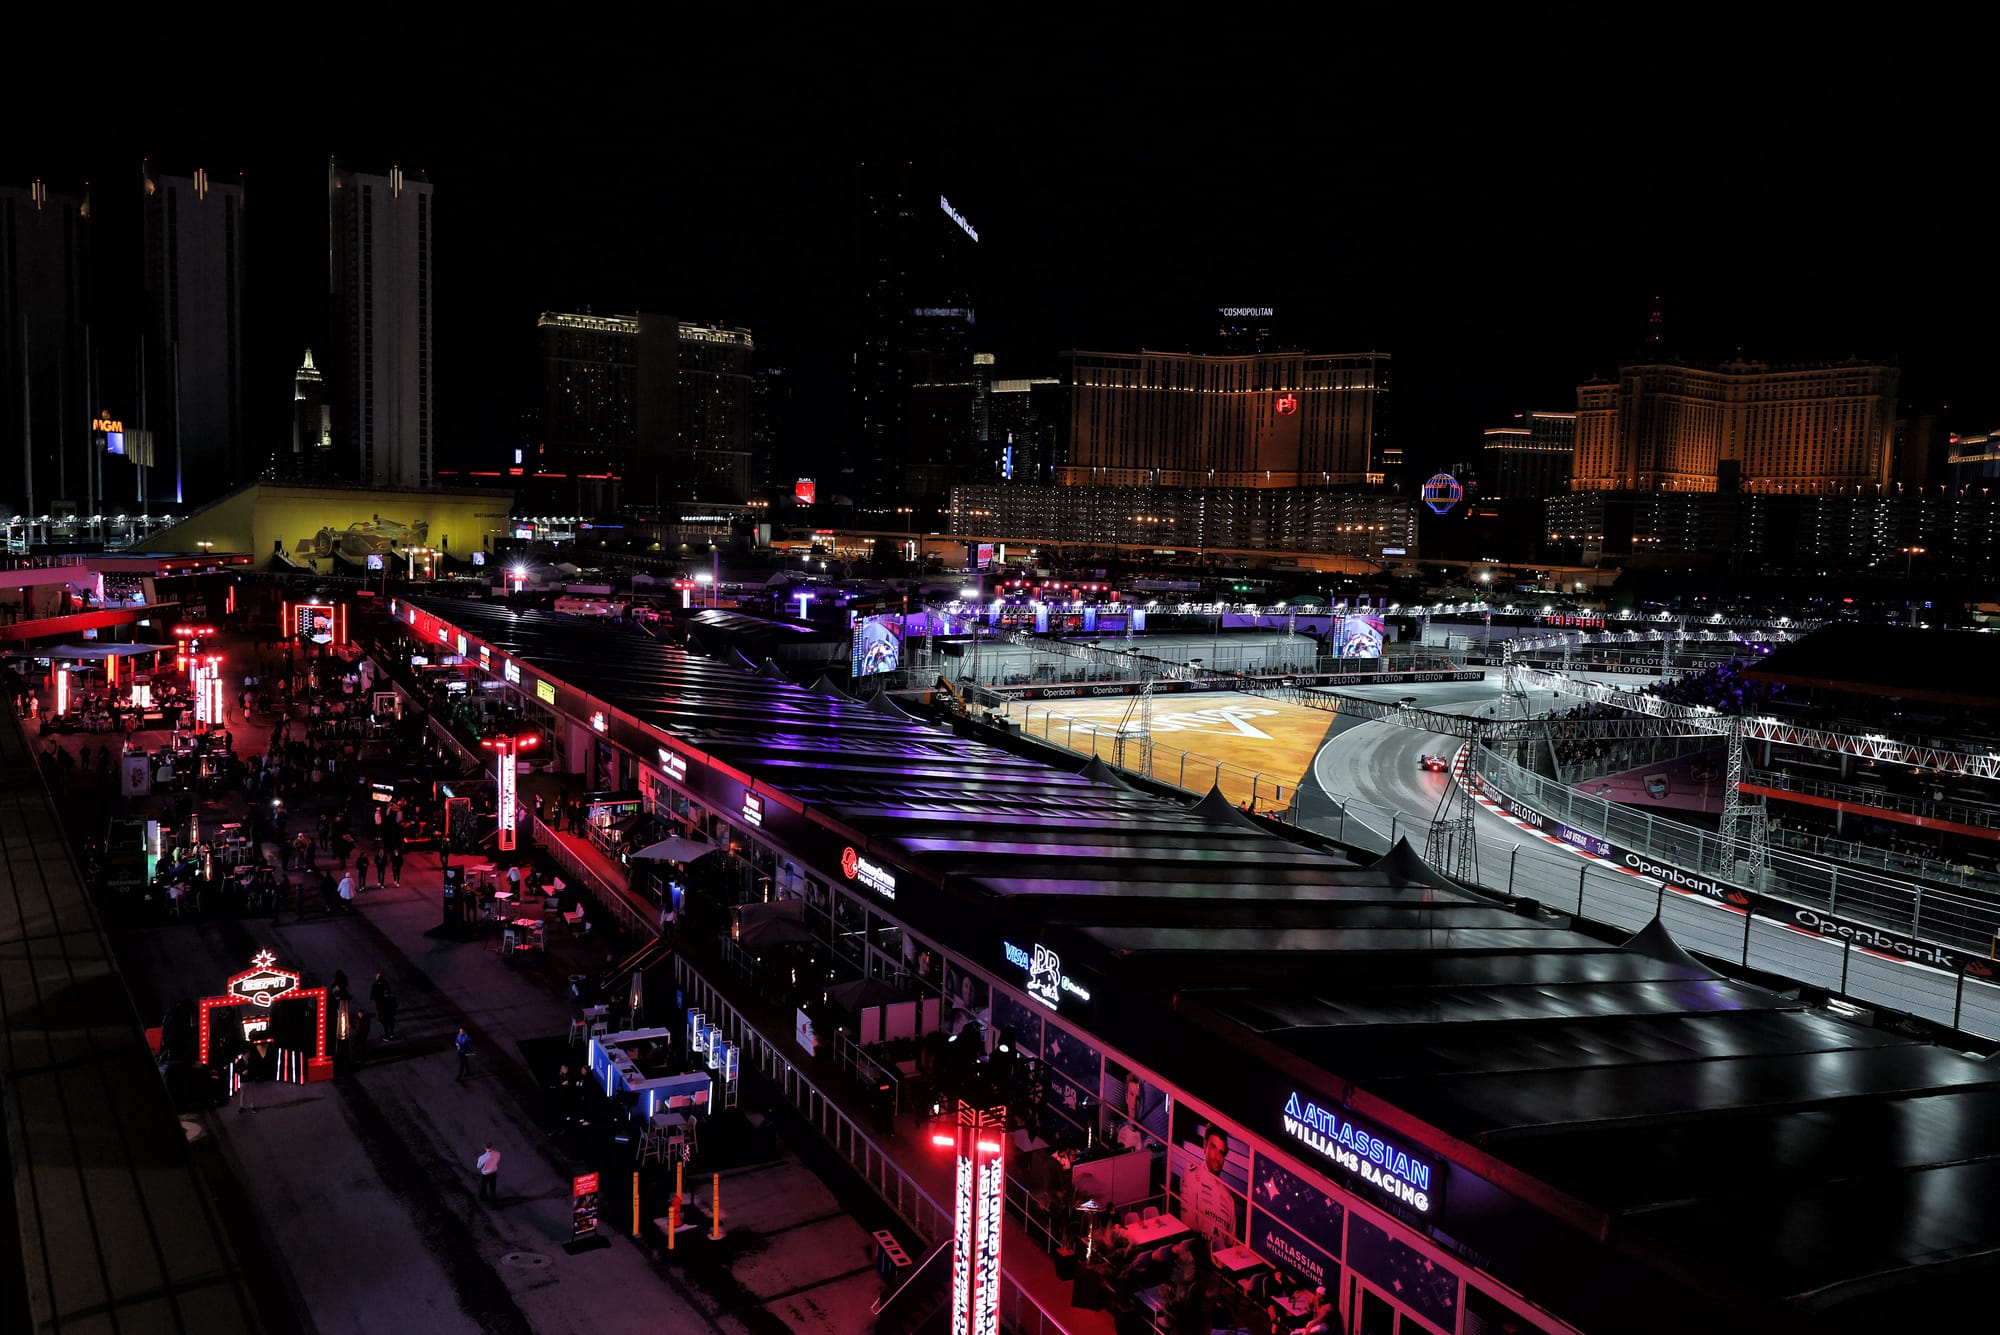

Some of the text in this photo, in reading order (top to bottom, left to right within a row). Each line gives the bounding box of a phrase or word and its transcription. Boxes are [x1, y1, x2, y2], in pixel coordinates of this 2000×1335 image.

[1223, 307, 1273, 316] COSMOPOLITAN
[93, 419, 123, 432] MGM
[1606, 665, 1650, 674] PELOTON
[1692, 660, 1722, 668] PELOT
[1329, 676, 1361, 685] PELOTON
[1372, 674, 1403, 683] PELOTON
[1414, 673, 1443, 682] PELOTON
[1453, 672, 1481, 680] PELOTON
[1043, 687, 1076, 698] Openbank
[1092, 686, 1124, 696] Openbank
[1482, 782, 1503, 804] PELOTON
[1510, 802, 1543, 827] PELOTON
[1563, 828, 1572, 841] LAS
[1571, 832, 1587, 847] VEGAS
[1625, 853, 1725, 898] Openbank
[1795, 910, 1954, 967] Openbank
[1004, 941, 1029, 970] VISA
[242, 977, 286, 992] ESPN
[1303, 1102, 1430, 1190] ATLASSIAN
[1283, 1114, 1429, 1212] WILLIAMS RACING
[964, 1157, 973, 1197] PRIX
[963, 1198, 972, 1257] GRAND
[984, 1156, 1002, 1335] AS VEGAS GRAND PRIX
[1266, 1242, 1323, 1286] WILLIAMS RACING
[1274, 1236, 1324, 1278] ATLASSIAN
[974, 1270, 988, 1335] ORMULA
